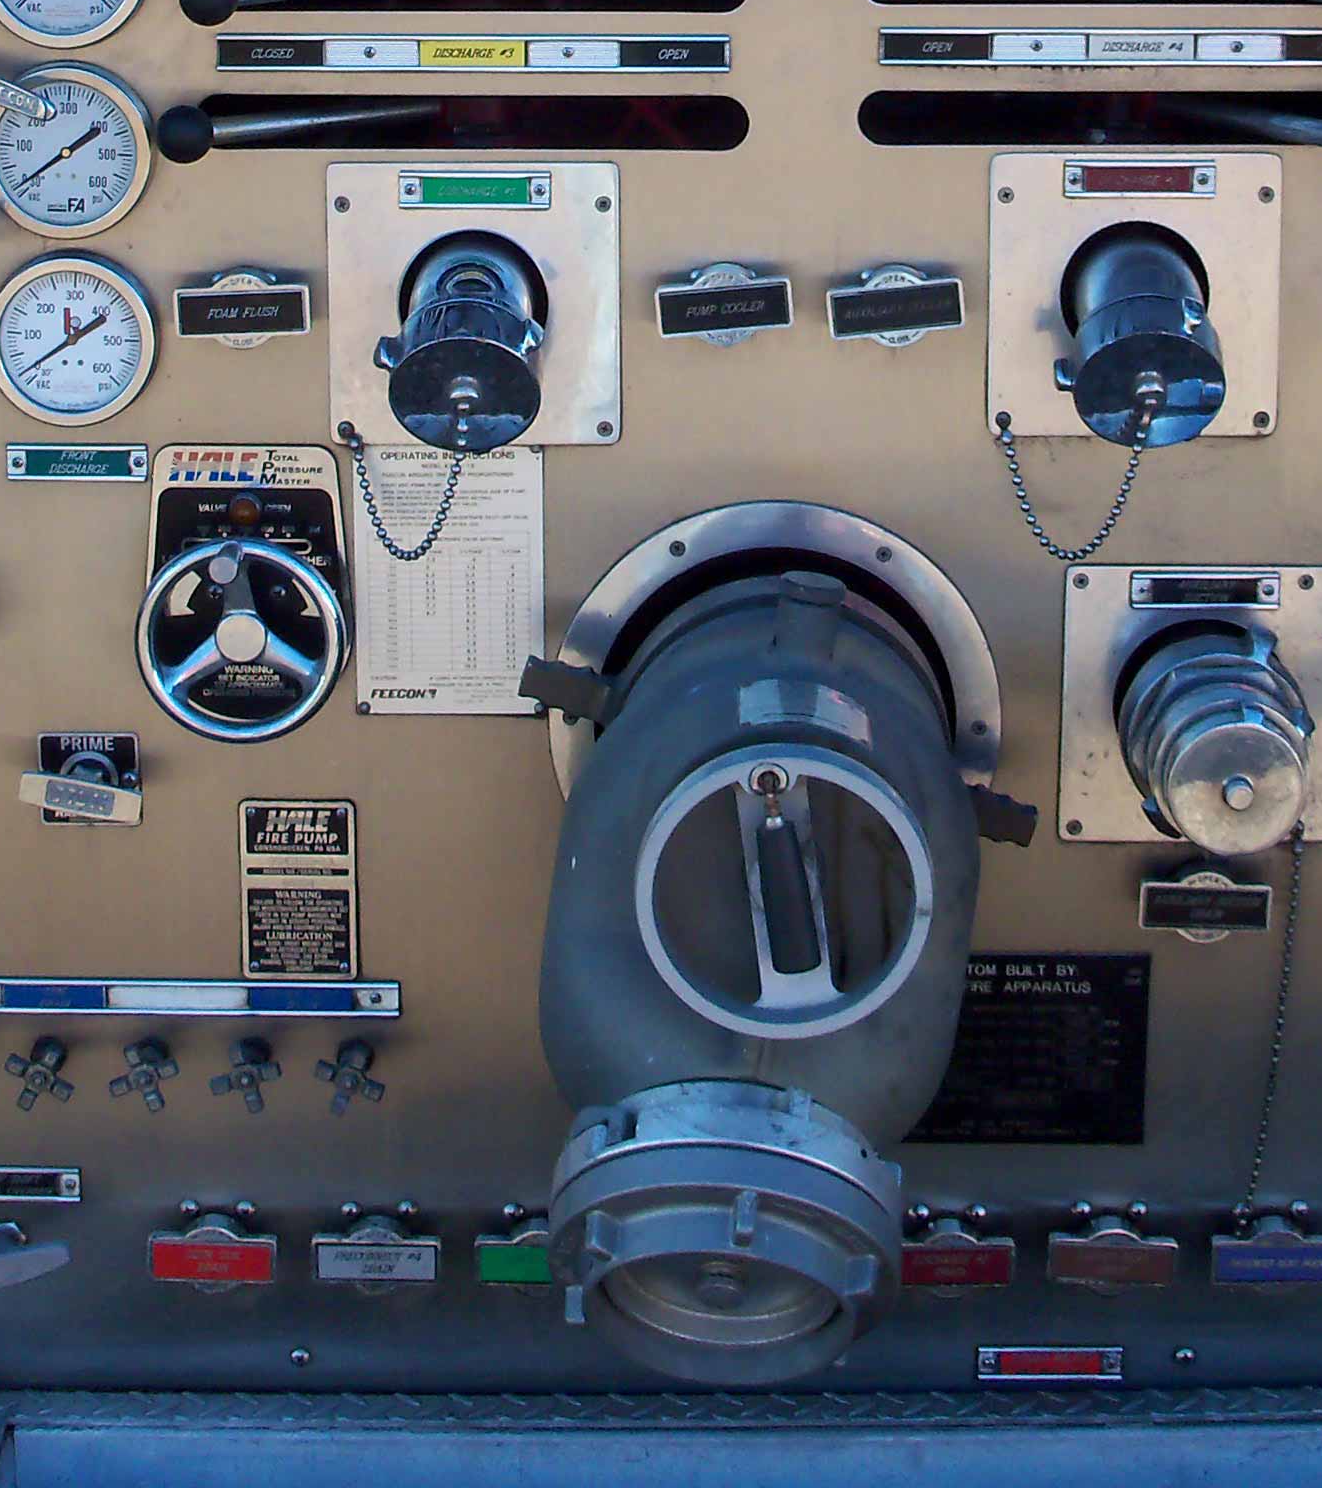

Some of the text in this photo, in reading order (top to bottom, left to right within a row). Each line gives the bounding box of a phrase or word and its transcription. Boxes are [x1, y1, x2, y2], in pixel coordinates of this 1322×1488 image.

[921, 40, 953, 53] OPEN
[1101, 40, 1184, 53] DISCHARGE #4
[250, 48, 294, 60] CLOSED
[433, 47, 515, 60] DISCHARGE #3
[657, 48, 690, 61] OPEN
[59, 102, 78, 114] 300
[15, 139, 33, 152] 100
[98, 148, 117, 161] 500
[88, 176, 107, 189] 600
[65, 290, 85, 302] 300
[36, 303, 56, 314] 200
[207, 306, 280, 320] FOAM FLUSH
[685, 301, 766, 318] PUMP COOLER
[24, 329, 42, 340] 100
[103, 335, 123, 346] 500
[92, 363, 112, 374] 600
[59, 450, 97, 462] FRONT
[265, 449, 300, 461] TOTAL
[380, 451, 438, 461] OPERATING
[49, 463, 109, 475] DISCHARGE
[168, 451, 260, 482] HALE
[262, 462, 324, 474] PRESSURE
[260, 474, 311, 485] MASTER
[224, 665, 275, 674] WARNING
[370, 688, 426, 699] FEECON
[60, 736, 115, 752] PRIME
[266, 809, 331, 832] HALE
[256, 832, 339, 844] FIRE PUMP
[275, 890, 322, 899] WARNING
[265, 931, 334, 941] LUBRICATION
[967, 964, 1077, 976] TOM BUILT BY
[1003, 980, 1092, 993] APPARATUS
